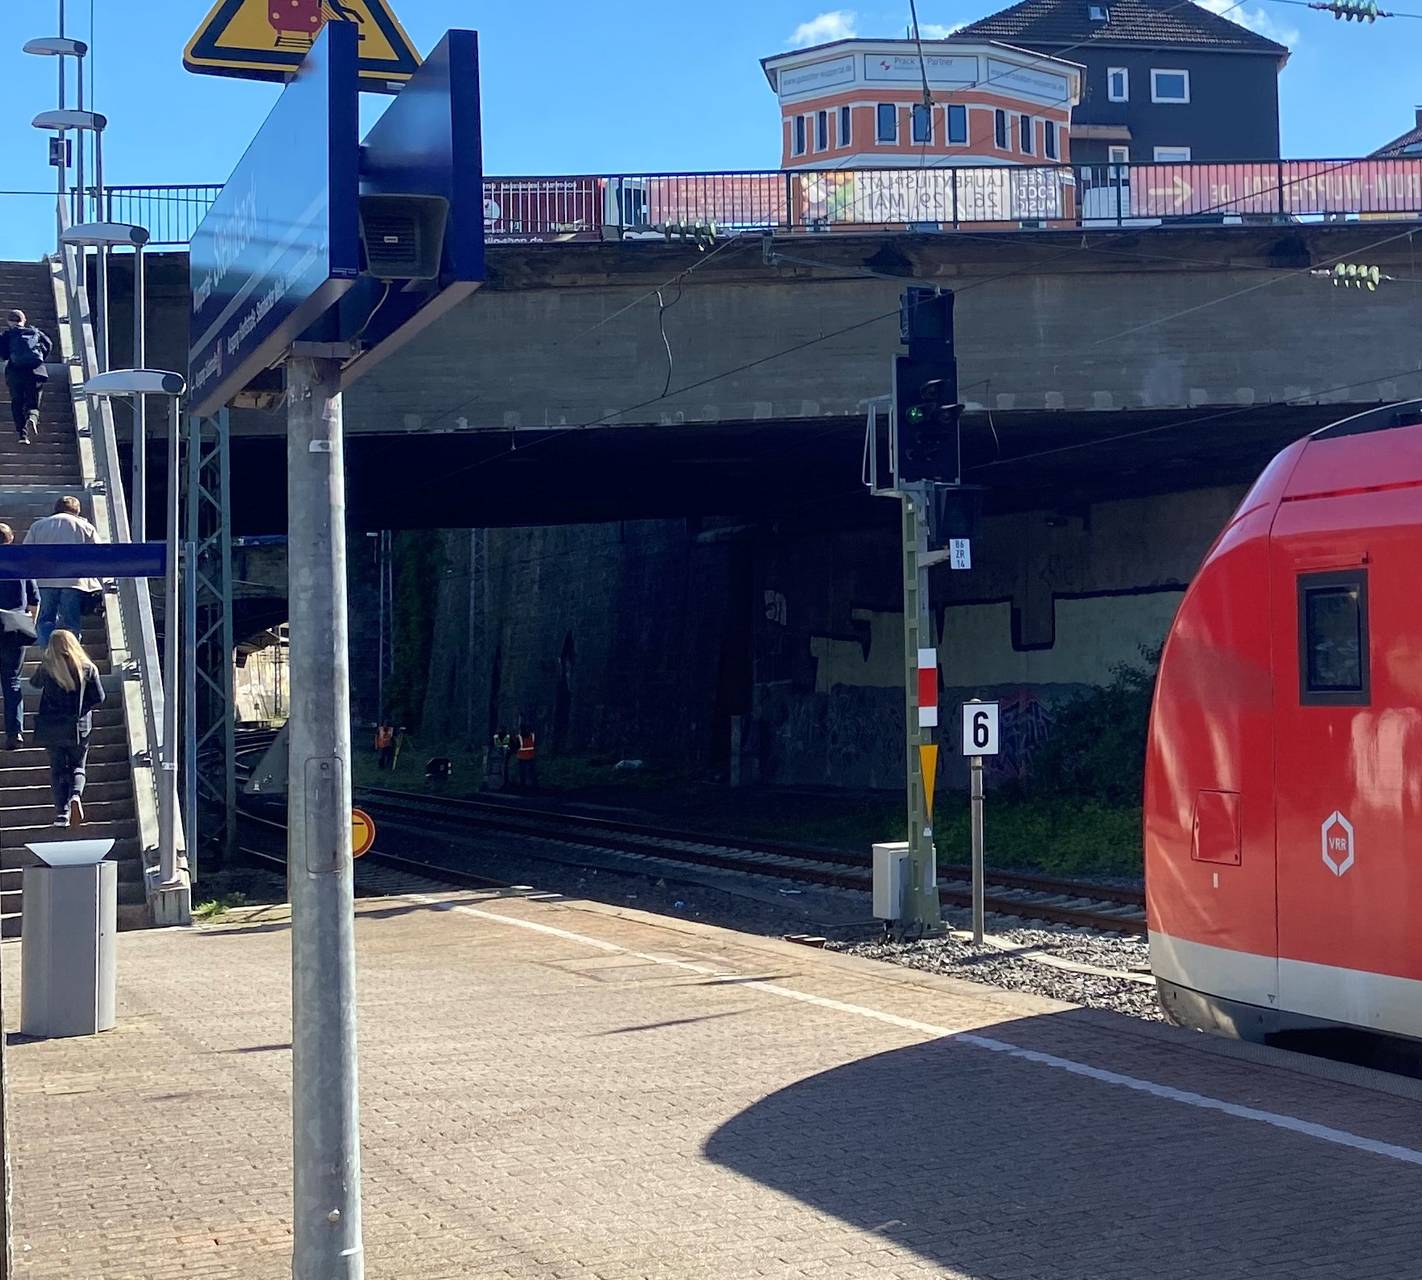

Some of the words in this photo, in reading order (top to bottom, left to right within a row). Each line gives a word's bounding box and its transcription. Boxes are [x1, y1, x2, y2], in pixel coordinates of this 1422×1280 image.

[927, 57, 954, 66] Partner
[955, 550, 965, 559] ZR
[973, 711, 989, 748] 6
[1328, 837, 1348, 853] VRR
